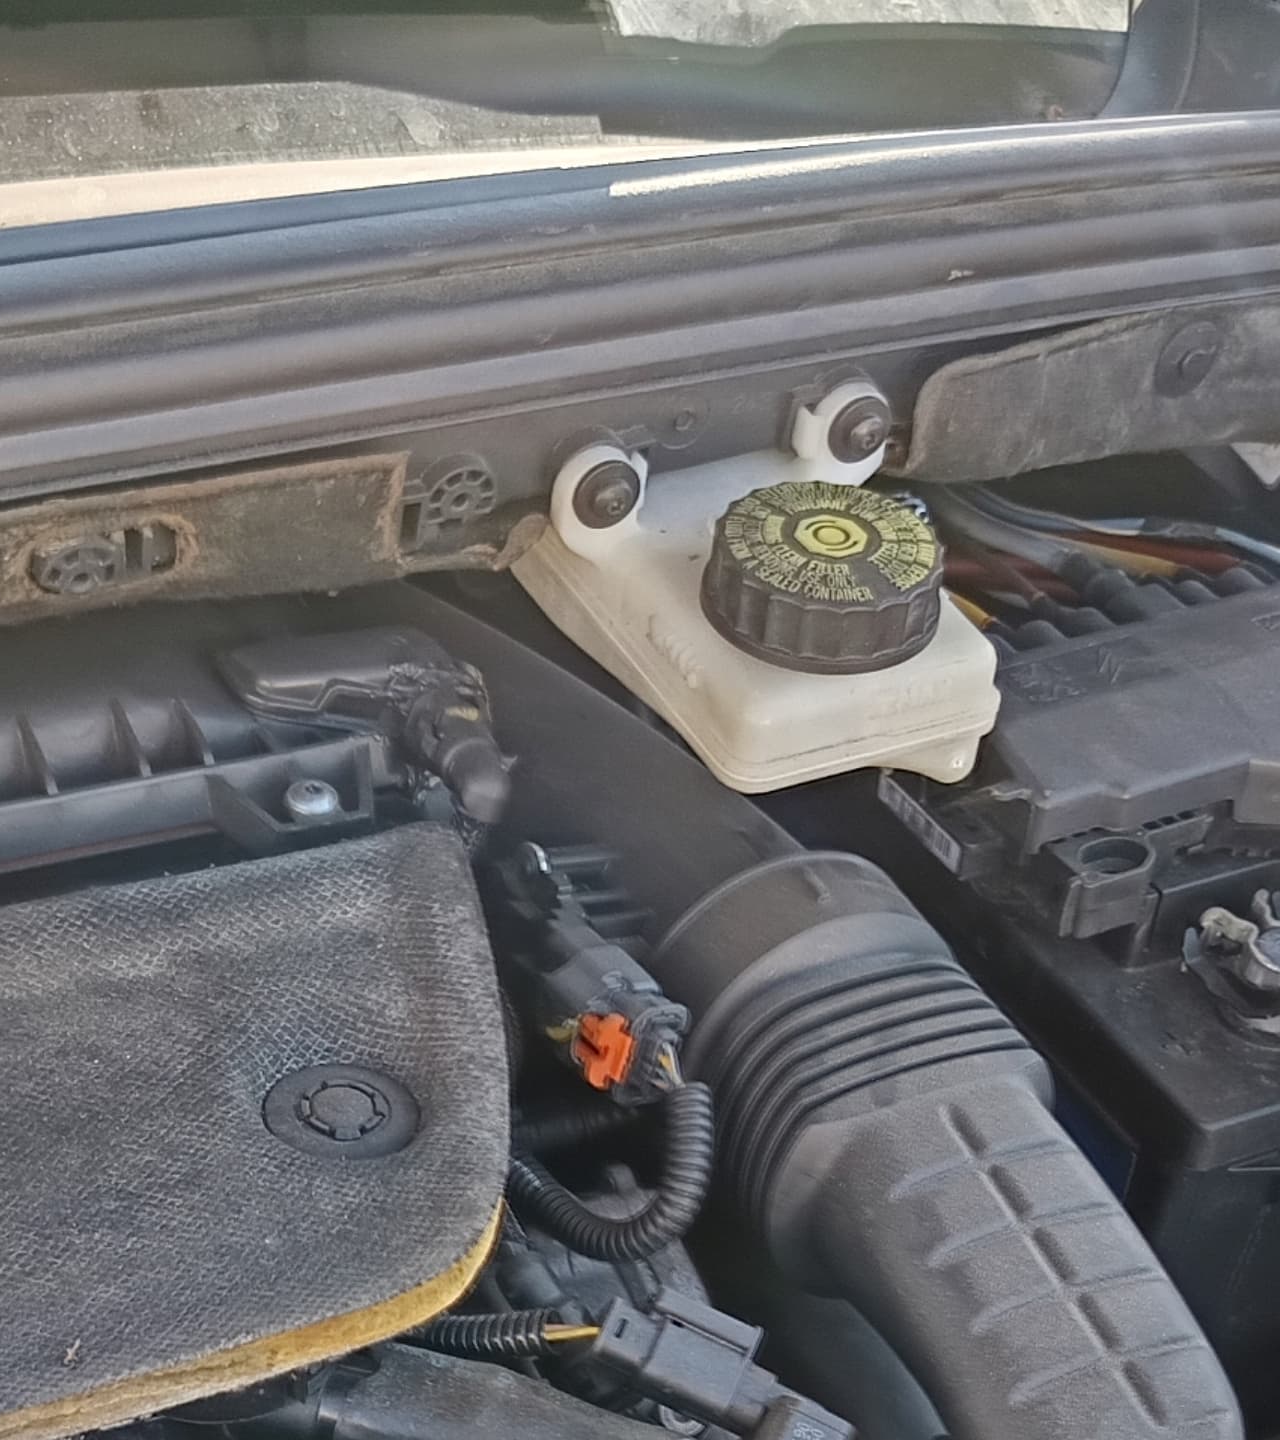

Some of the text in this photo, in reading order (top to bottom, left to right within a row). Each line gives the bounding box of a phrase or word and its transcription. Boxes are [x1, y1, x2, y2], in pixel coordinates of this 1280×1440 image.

[807, 559, 850, 575] FILLER
[755, 565, 801, 593] SEALED
[803, 583, 874, 602] CONTAINER
[827, 574, 856, 588] ONLY
